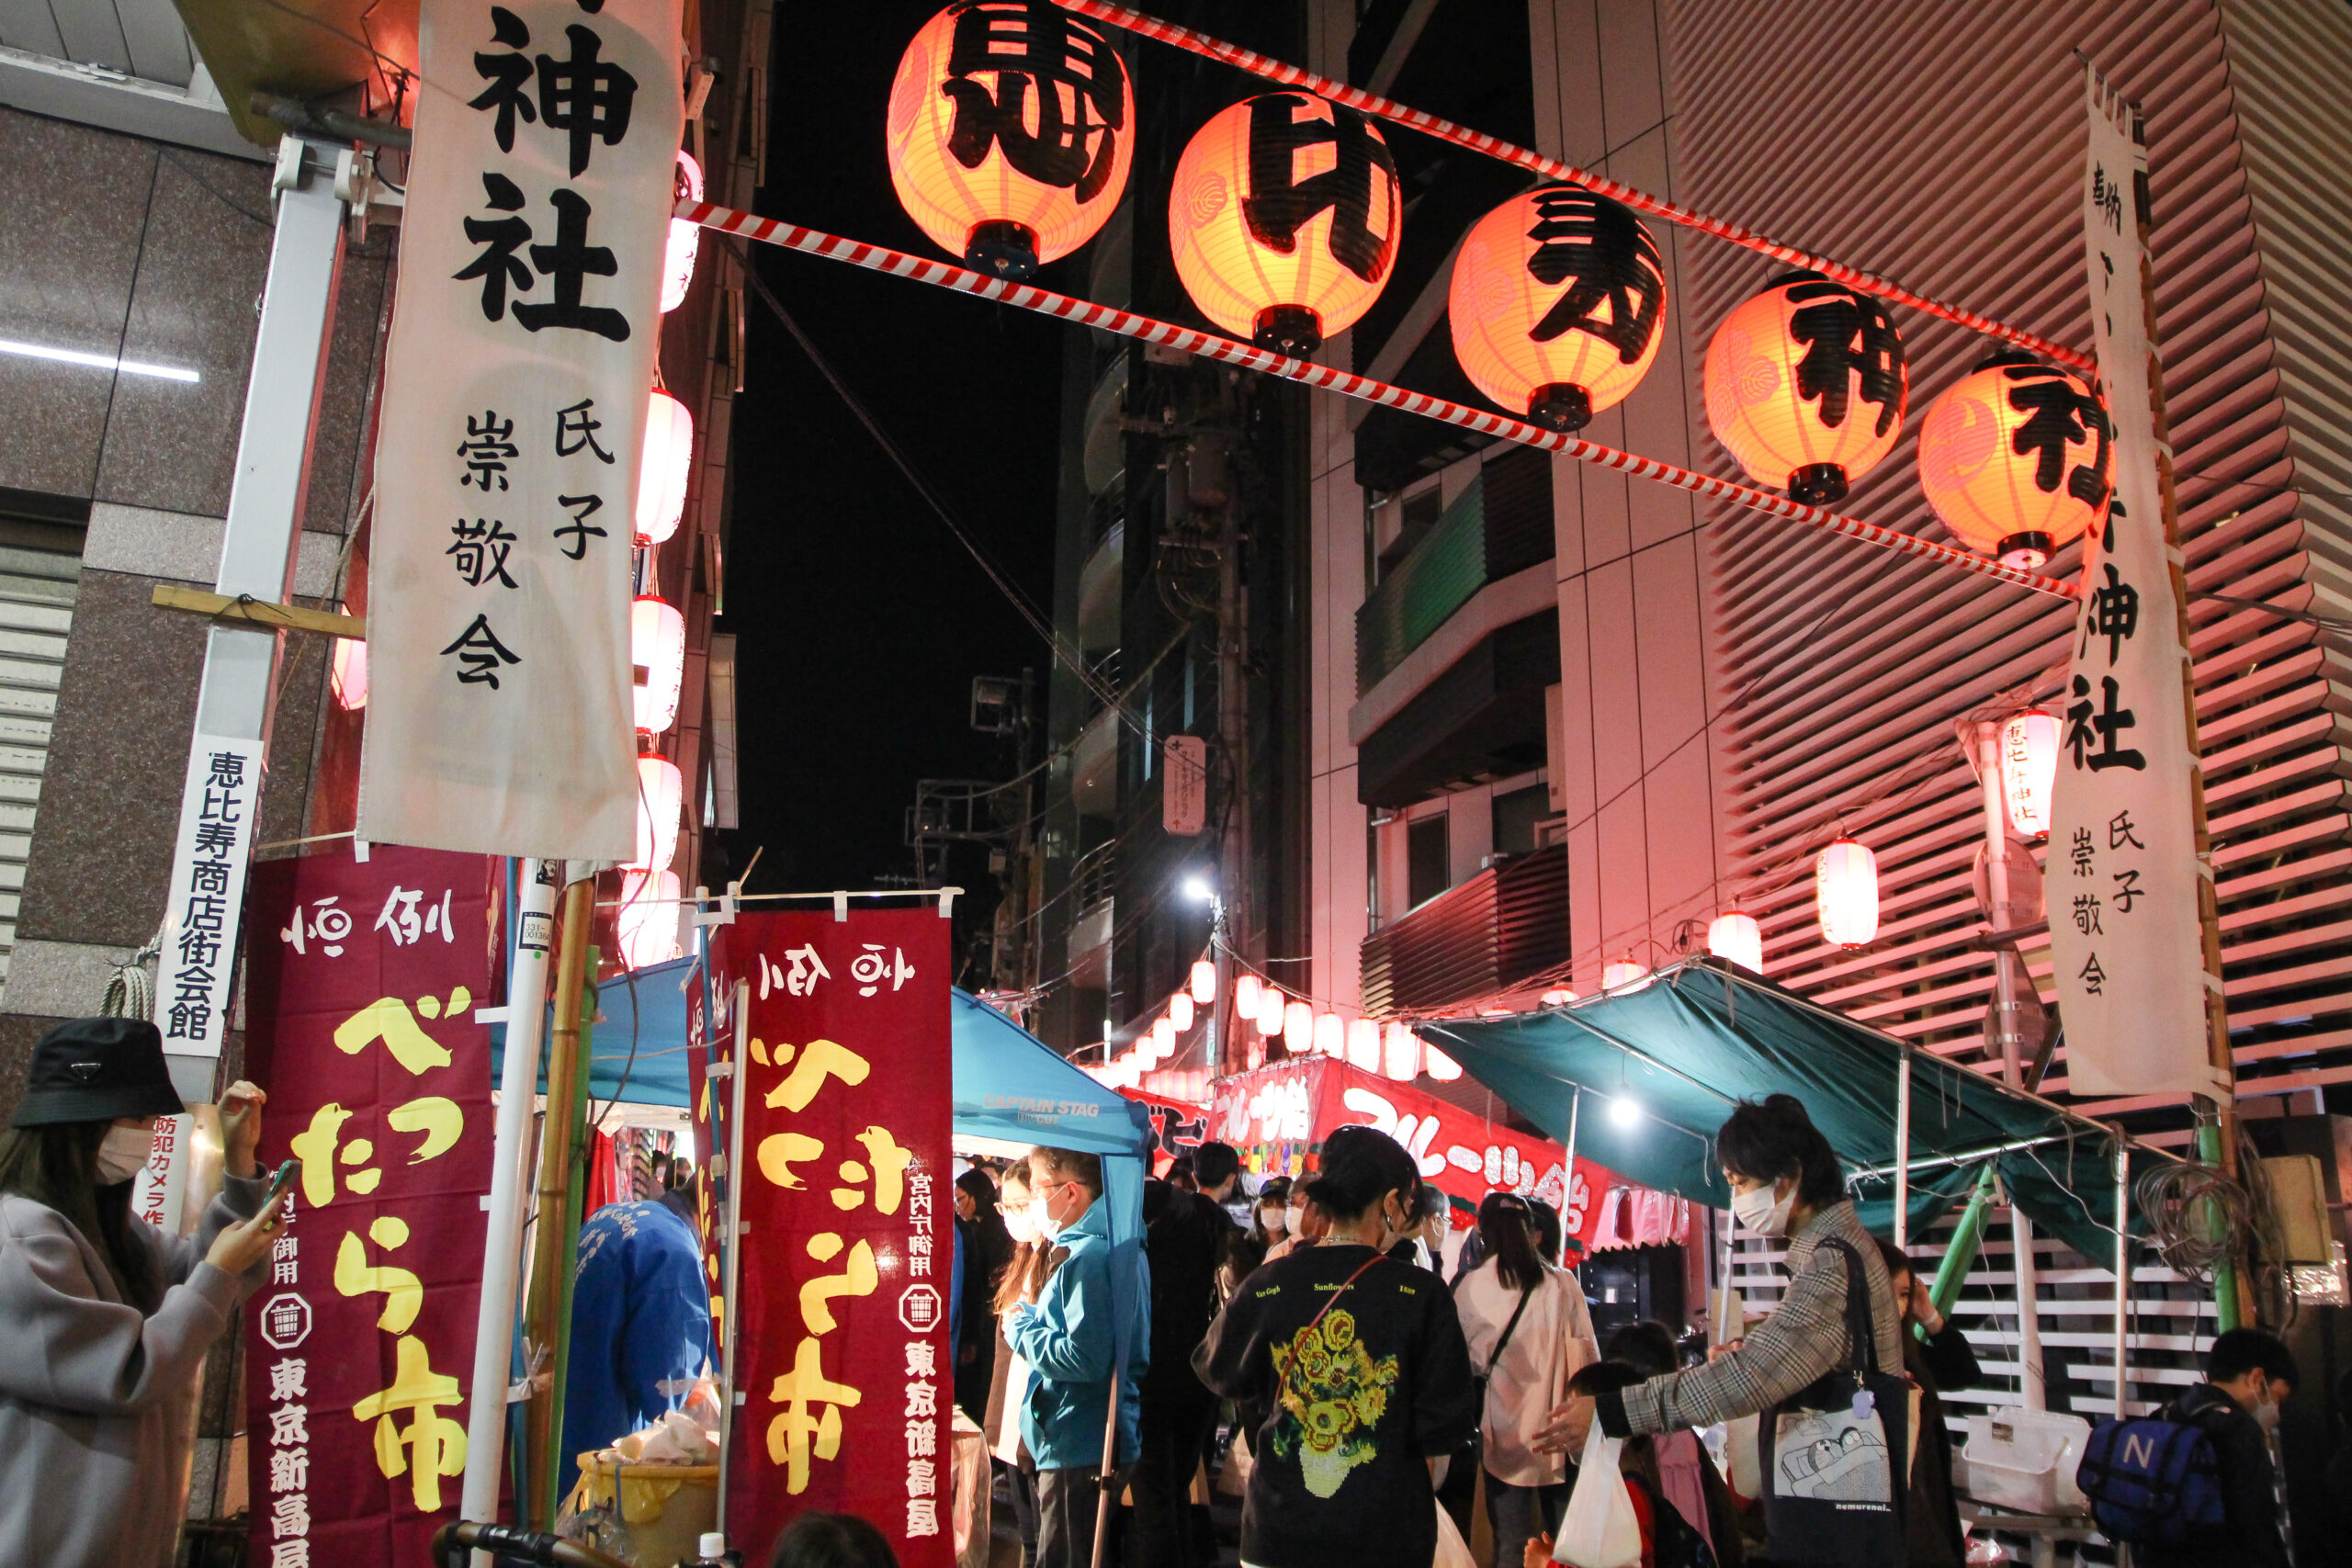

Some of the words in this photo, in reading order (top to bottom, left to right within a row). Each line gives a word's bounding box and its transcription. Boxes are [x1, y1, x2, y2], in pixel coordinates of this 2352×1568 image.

[451, 0, 641, 342] 神社
[1788, 282, 1911, 439] 神
[2007, 366, 2110, 511] 社
[440, 411, 522, 690] 崇敬会
[553, 398, 616, 560] 氏子
[166, 751, 248, 1042] 恵比寿商店街会館
[2071, 826, 2107, 997] 崇敬会
[2109, 809, 2145, 913] 氏子
[984, 1095, 1054, 1114] CAPTAIN
[1057, 1101, 1099, 1118] STAG
[2123, 1433, 2154, 1469] N
